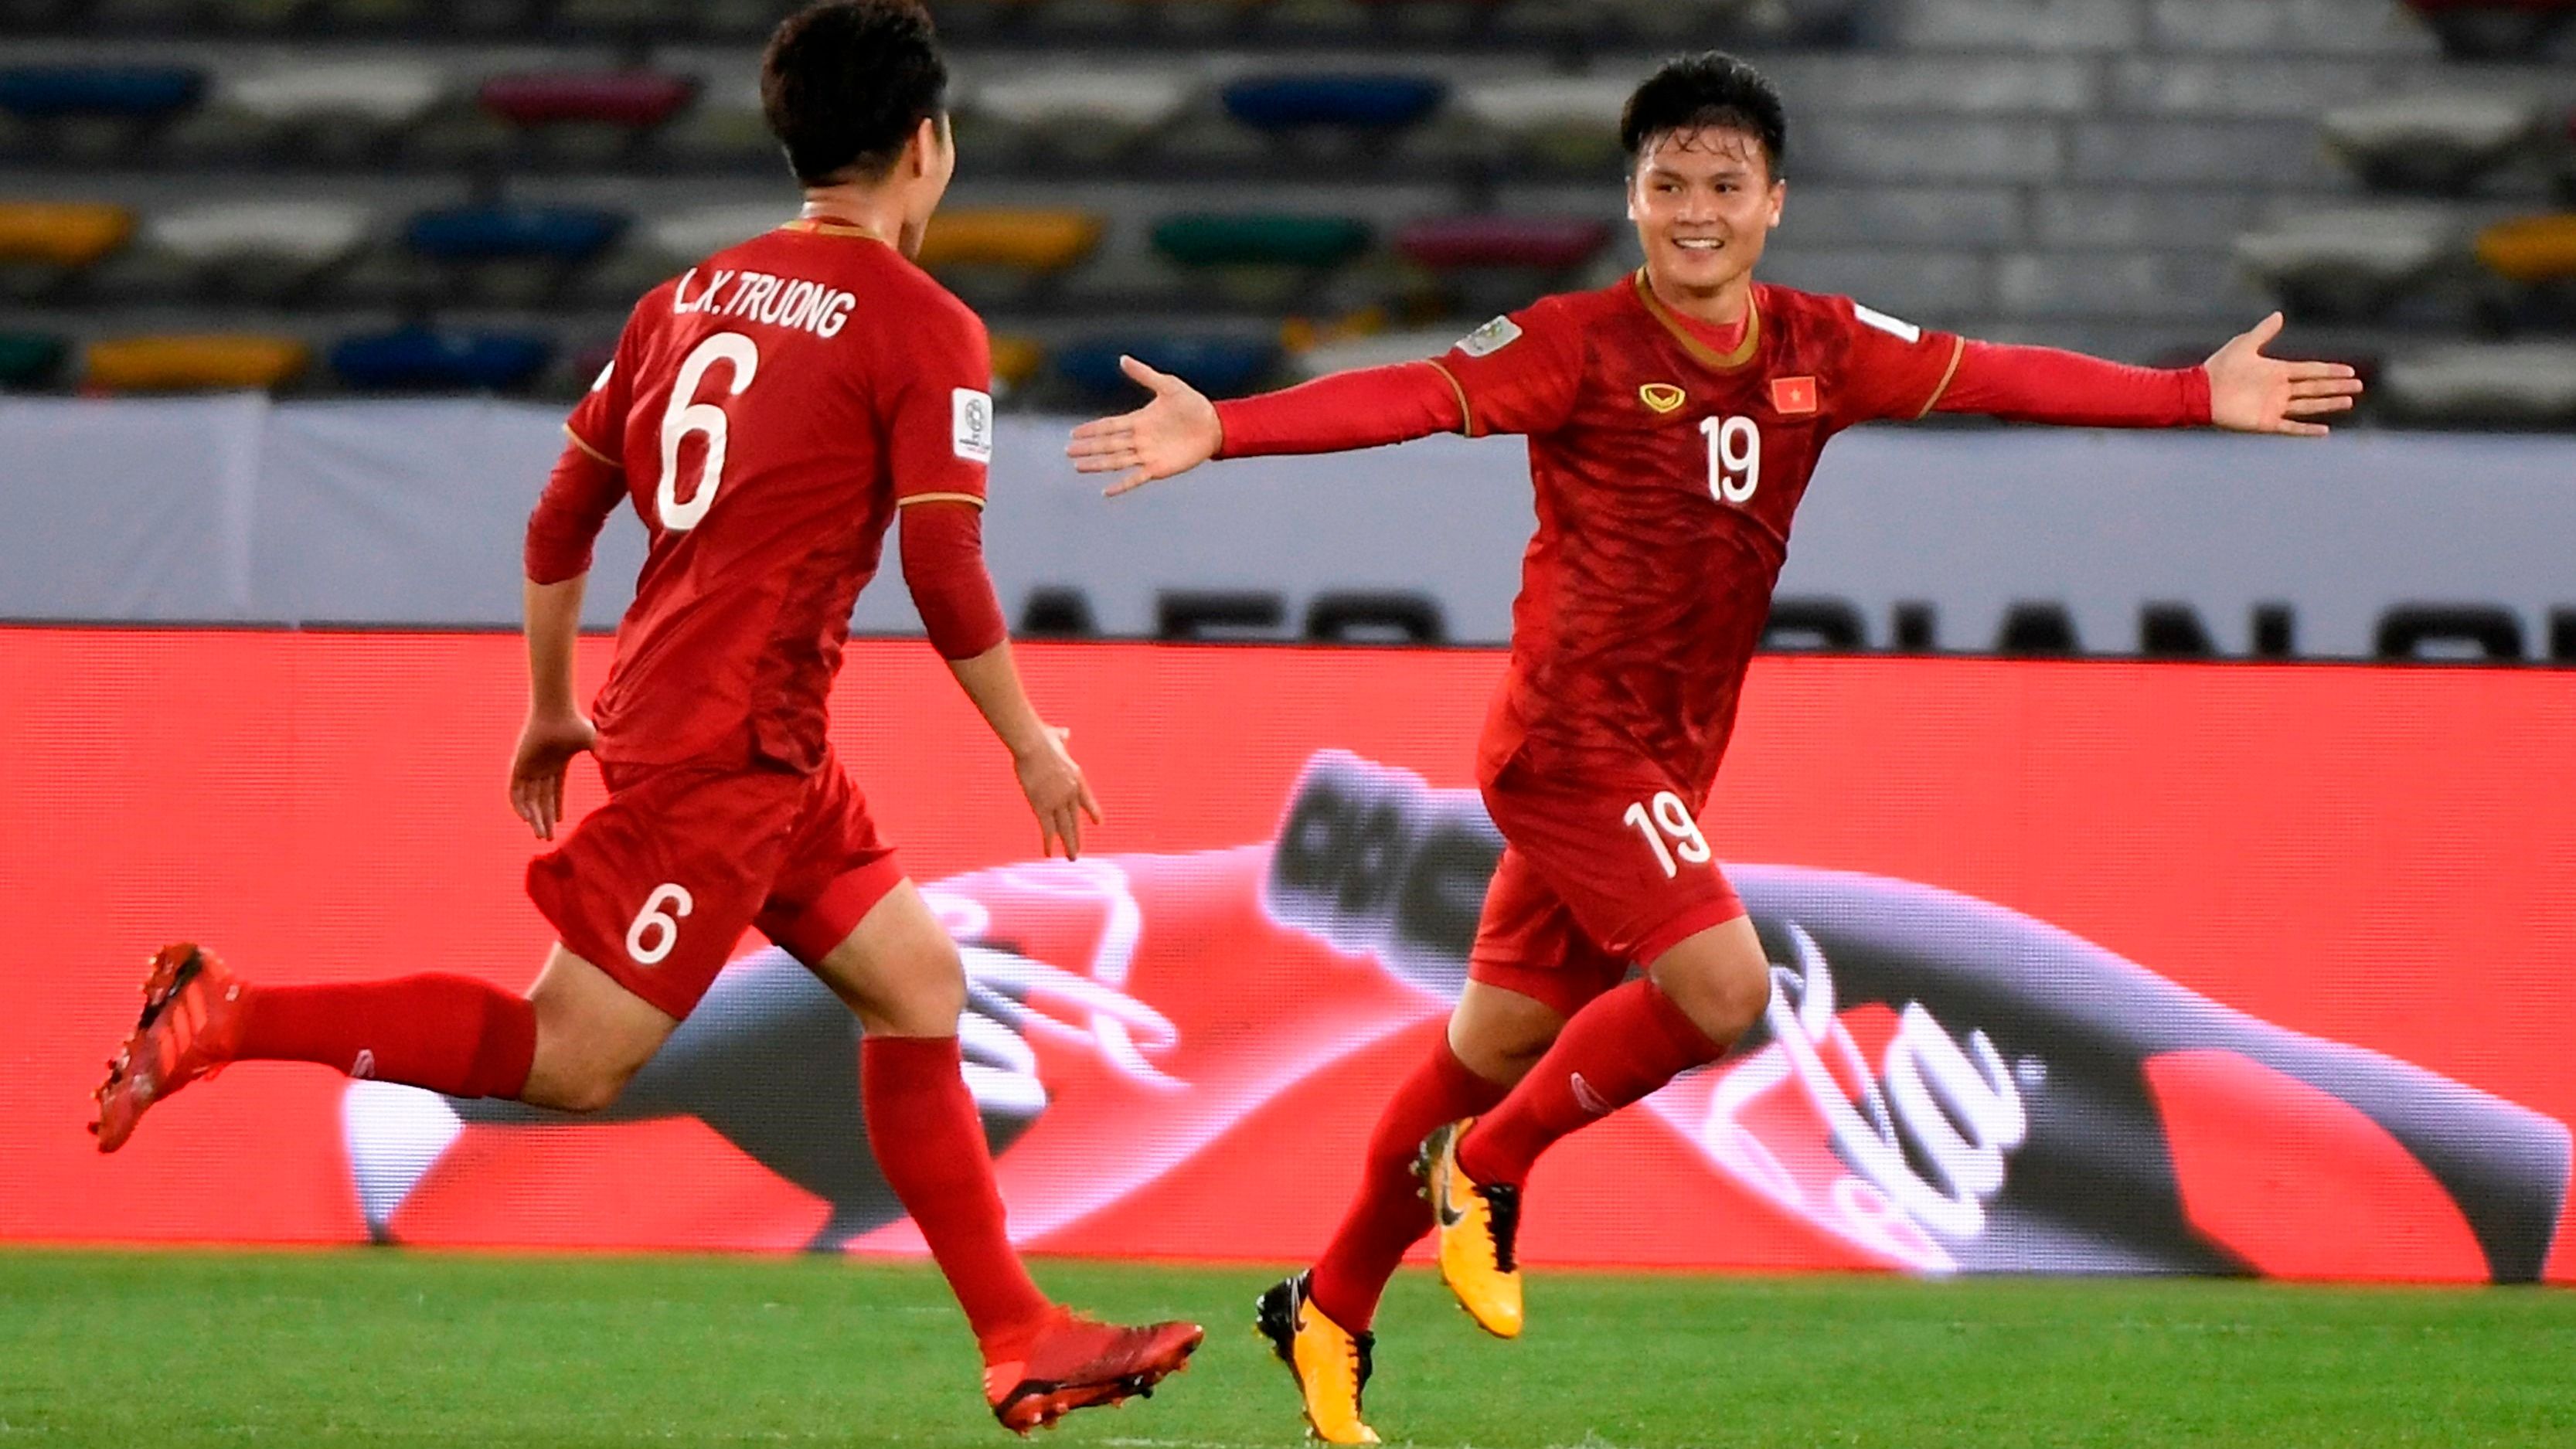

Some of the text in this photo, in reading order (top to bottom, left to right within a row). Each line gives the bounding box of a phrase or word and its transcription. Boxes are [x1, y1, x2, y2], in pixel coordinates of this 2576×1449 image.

[657, 332, 758, 531] 6
[1700, 416, 1761, 502] 19
[1624, 791, 1711, 879] 19
[626, 883, 693, 964] 6
